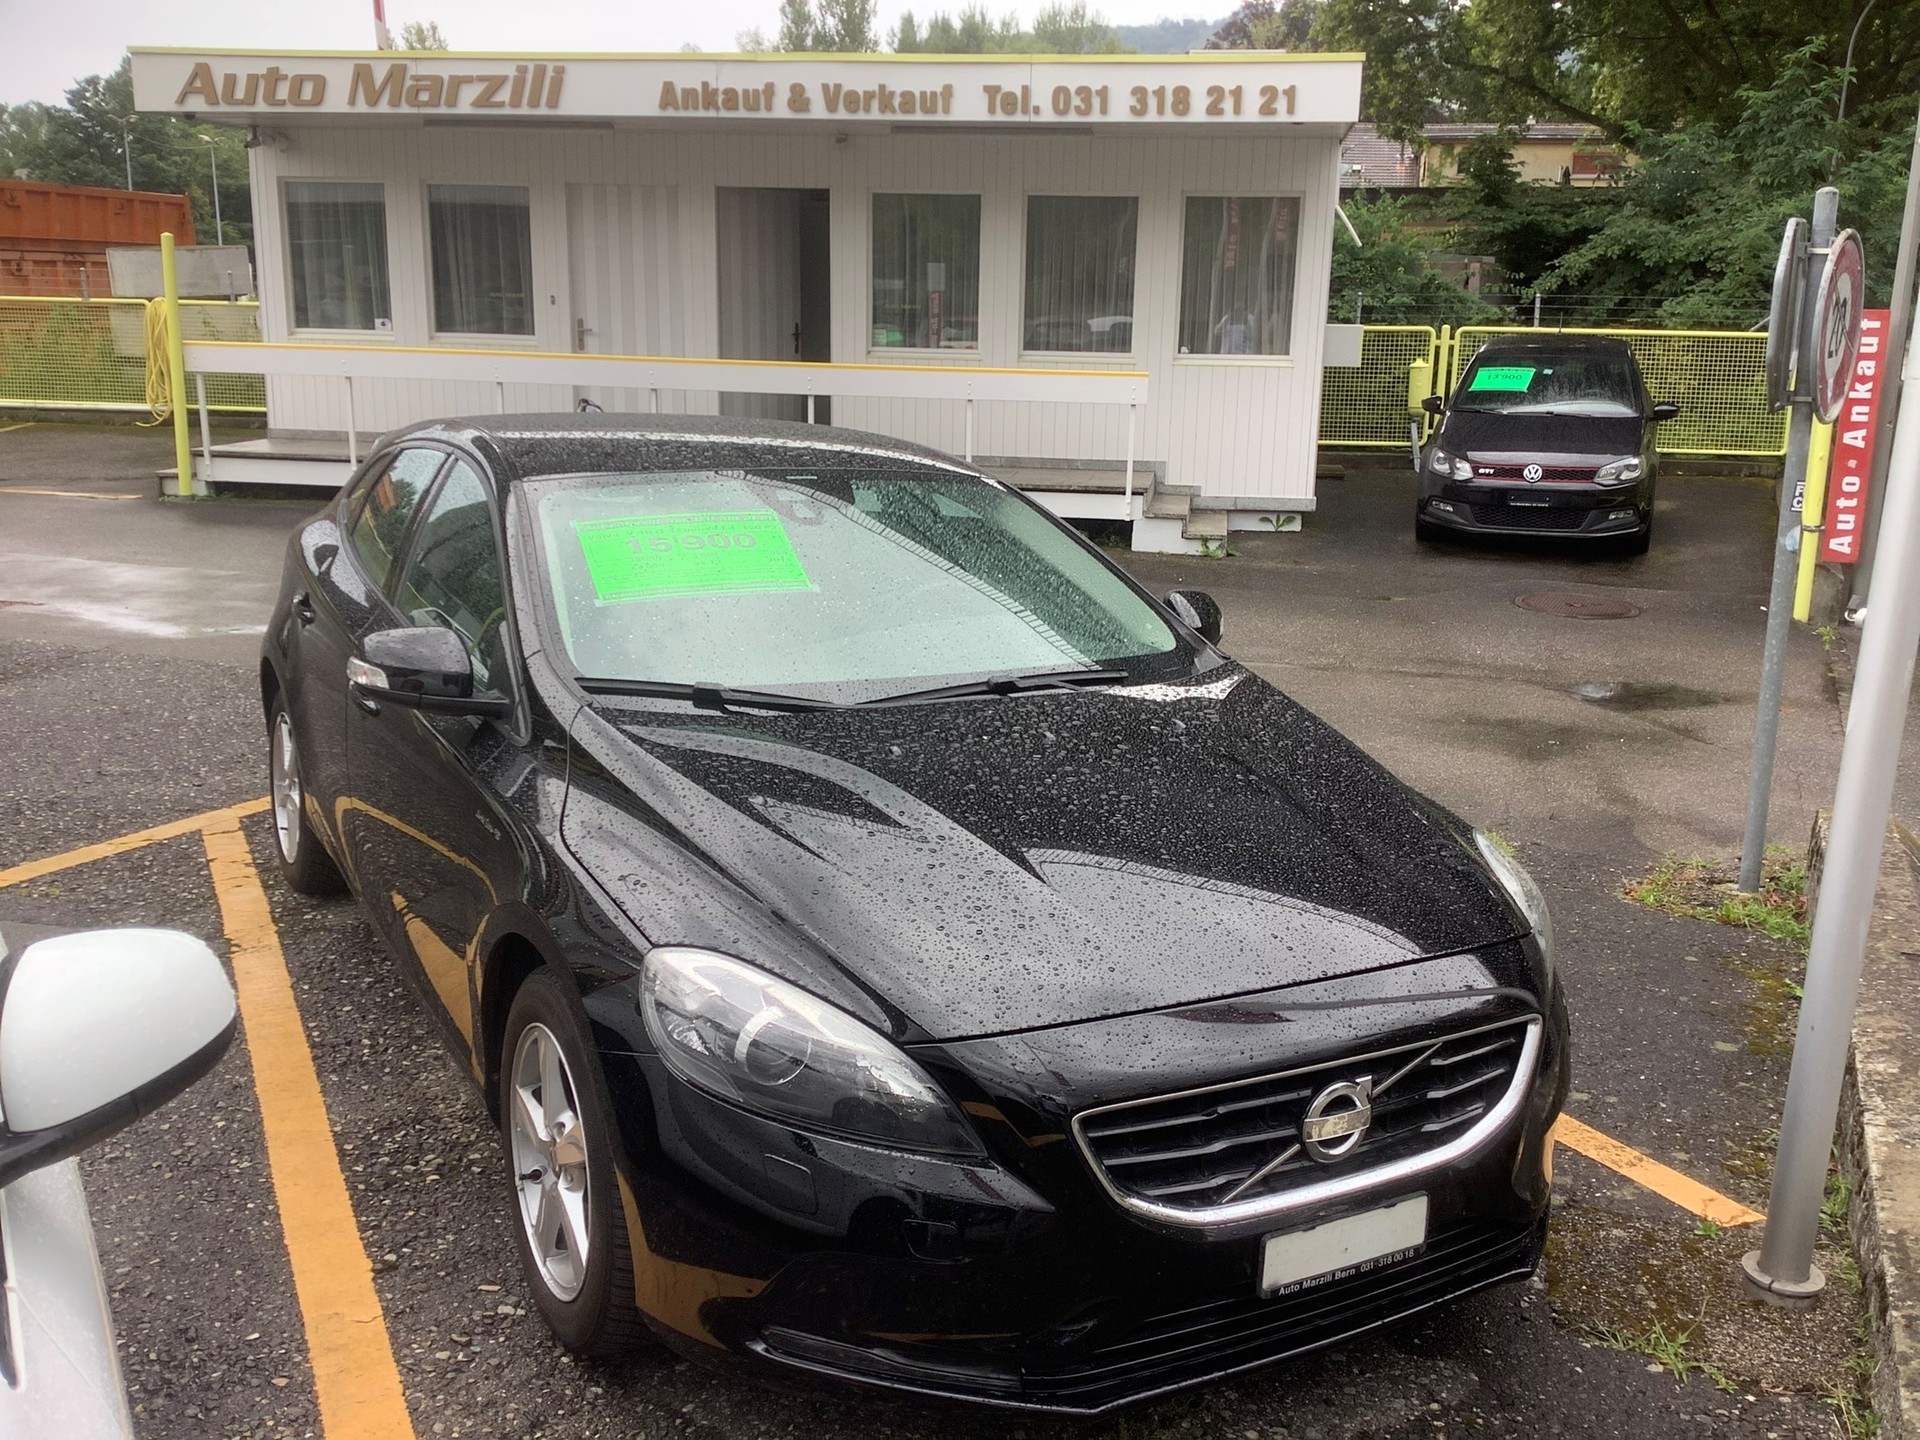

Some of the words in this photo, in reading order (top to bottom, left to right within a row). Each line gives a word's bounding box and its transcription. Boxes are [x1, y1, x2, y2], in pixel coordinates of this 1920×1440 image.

[175, 62, 326, 107] Auto
[347, 63, 565, 109] Marzili
[658, 80, 775, 112] Ankauf
[787, 82, 810, 113] &
[821, 83, 954, 115] Verkauf
[983, 84, 1041, 116] Tel.
[1051, 85, 1109, 116] 031
[1129, 85, 1191, 117] 318
[1205, 85, 1243, 117] 21
[1258, 85, 1297, 117] 21
[1842, 317, 1882, 449] Ankauf
[1828, 475, 1861, 554] Auto
[1278, 1283, 1300, 1296] Auto
[1302, 1273, 1333, 1289] Marzili
[1334, 1268, 1356, 1281] Bern
[1393, 1251, 1404, 1262] 00
[1404, 1248, 1415, 1259] 18
